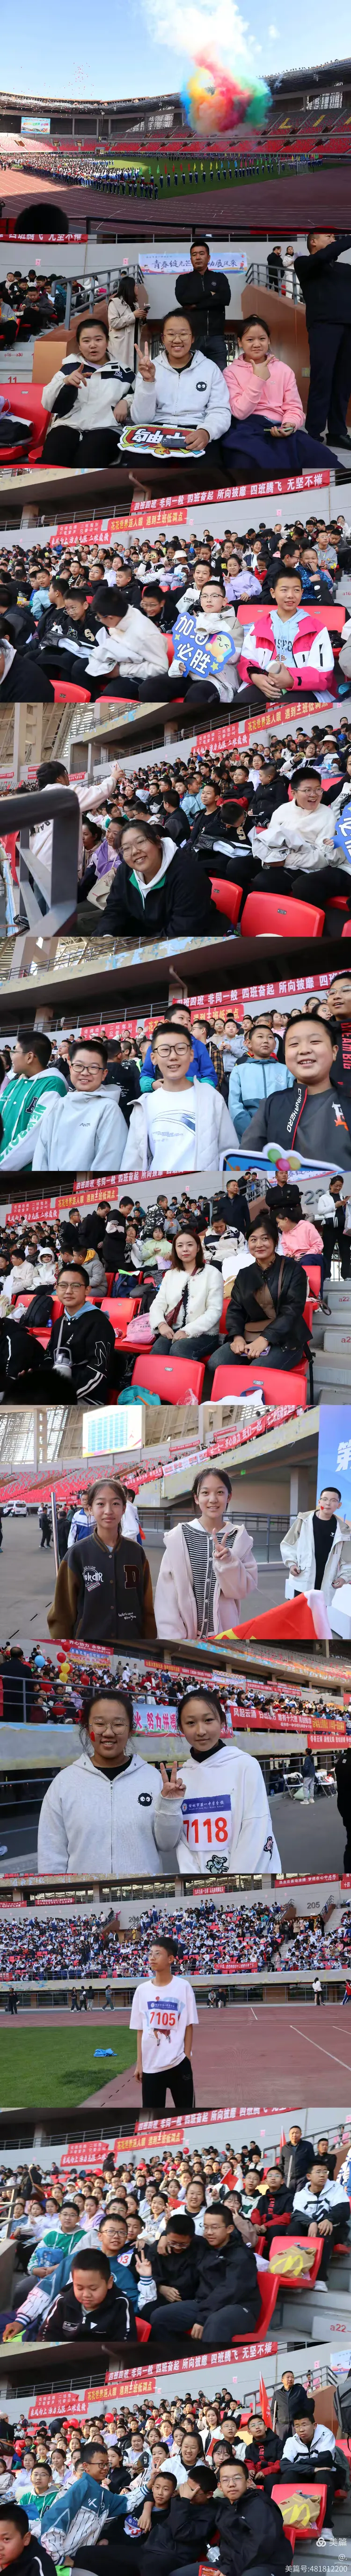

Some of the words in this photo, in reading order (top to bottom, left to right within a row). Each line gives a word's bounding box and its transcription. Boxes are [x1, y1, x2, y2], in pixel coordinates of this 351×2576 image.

[134, 499, 157, 511] 四班四班
[160, 497, 184, 507] 非同一般
[188, 490, 213, 503] 四班奋起
[217, 486, 246, 499] 所向披靡
[251, 481, 282, 495] 四班腾飞
[287, 474, 322, 491] 无坚不摧
[111, 518, 143, 531] 花花世界迷人眼
[146, 511, 183, 525] 遇到三班低调点
[84, 629, 95, 642] S
[177, 643, 211, 674] 必胜
[248, 711, 281, 732] 花花世界迷人眼
[236, 827, 246, 841] S
[208, 990, 238, 1003] 非同一般
[242, 983, 274, 998] 四班奋起
[279, 976, 314, 993] 所向披靡
[286, 1088, 301, 1133] CHINAHERO
[76, 1180, 94, 1189] 四班四班
[97, 1177, 116, 1187] 非同一般
[118, 1173, 139, 1183] 四班奋起
[123, 1565, 140, 1589] D
[146, 1711, 177, 1731] 努力拼搏
[234, 1708, 256, 1718] 风起云涌
[183, 1817, 228, 1843] 7118
[150, 2012, 176, 2026] 7105
[109, 2370, 129, 2381] 四班四班
[131, 2365, 153, 2378] 非同一般
[156, 2359, 179, 2373] 四班奋起
[182, 2354, 208, 2370] 所向披靡
[211, 2348, 238, 2364] 四班腾飞
[241, 2342, 272, 2359] 无坚不摧
